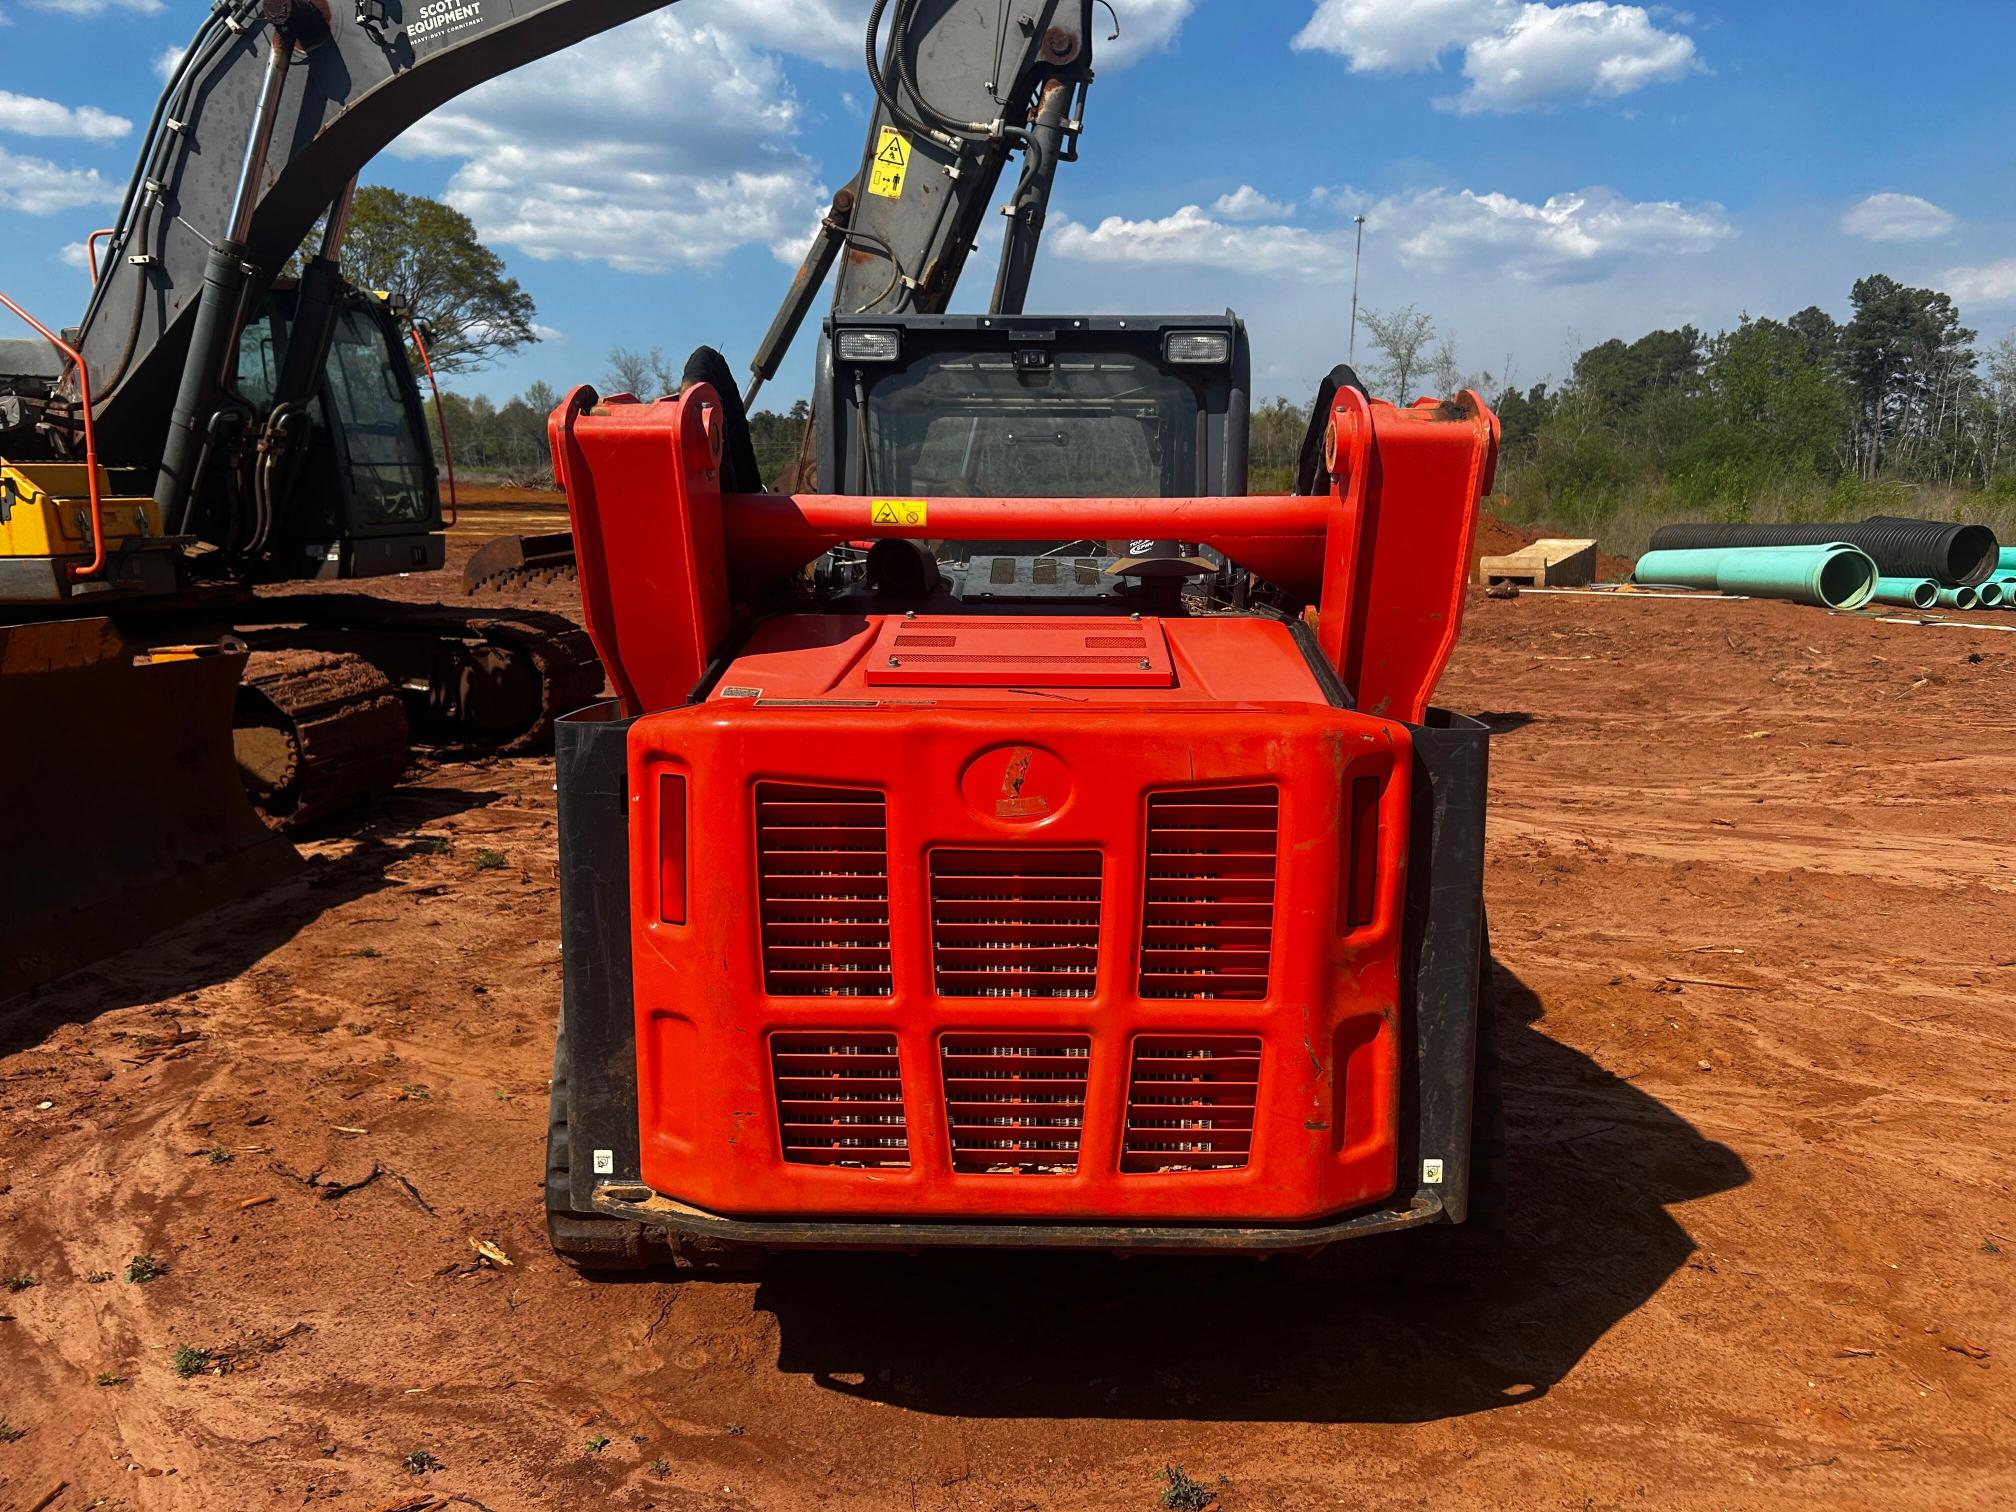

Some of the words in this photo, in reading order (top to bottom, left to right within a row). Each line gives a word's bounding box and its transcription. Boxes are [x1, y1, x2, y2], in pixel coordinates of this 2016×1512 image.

[420, 0, 461, 19] SCOTT
[406, 2, 480, 37] EQUIPMENT
[447, 17, 484, 34] COMMITMENT
